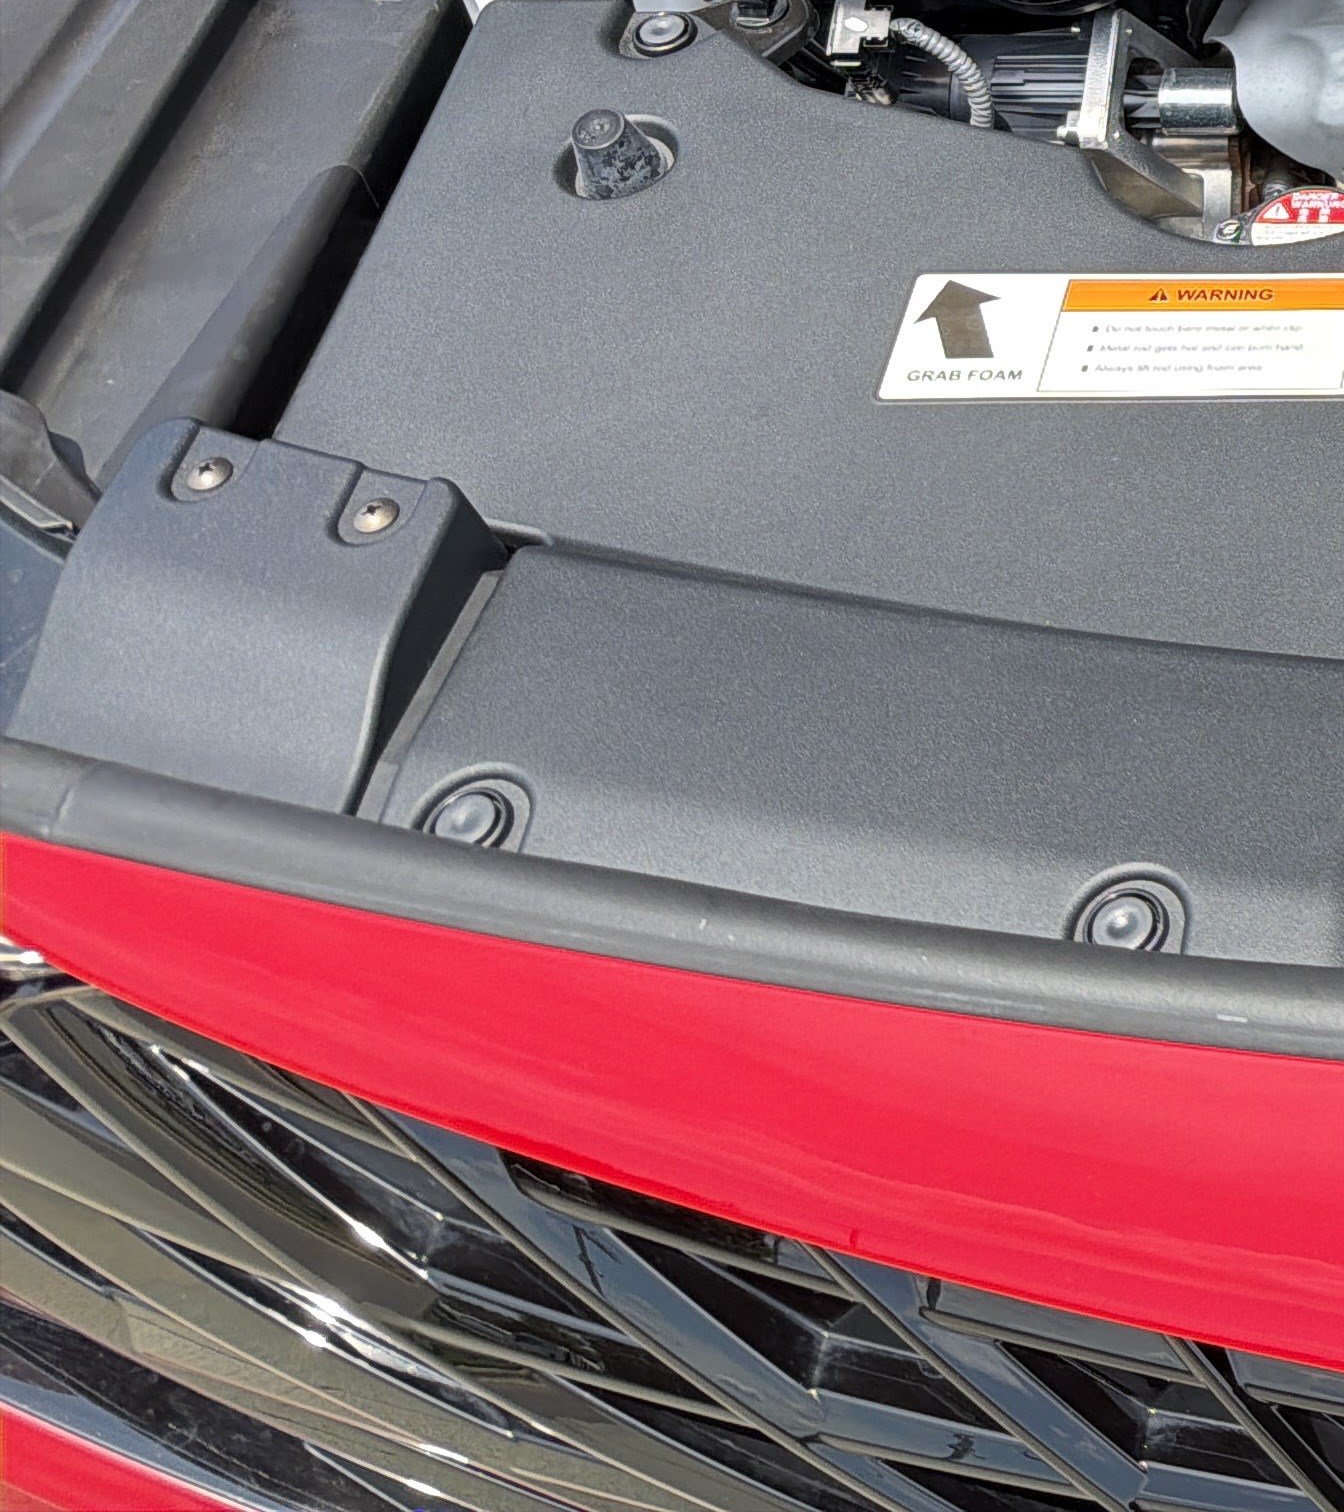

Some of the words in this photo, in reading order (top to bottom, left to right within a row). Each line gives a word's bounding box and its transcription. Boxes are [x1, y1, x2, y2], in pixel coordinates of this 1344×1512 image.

[1177, 288, 1275, 303] WARNING
[906, 369, 962, 382] GRAB
[967, 368, 1023, 382] FOAM
